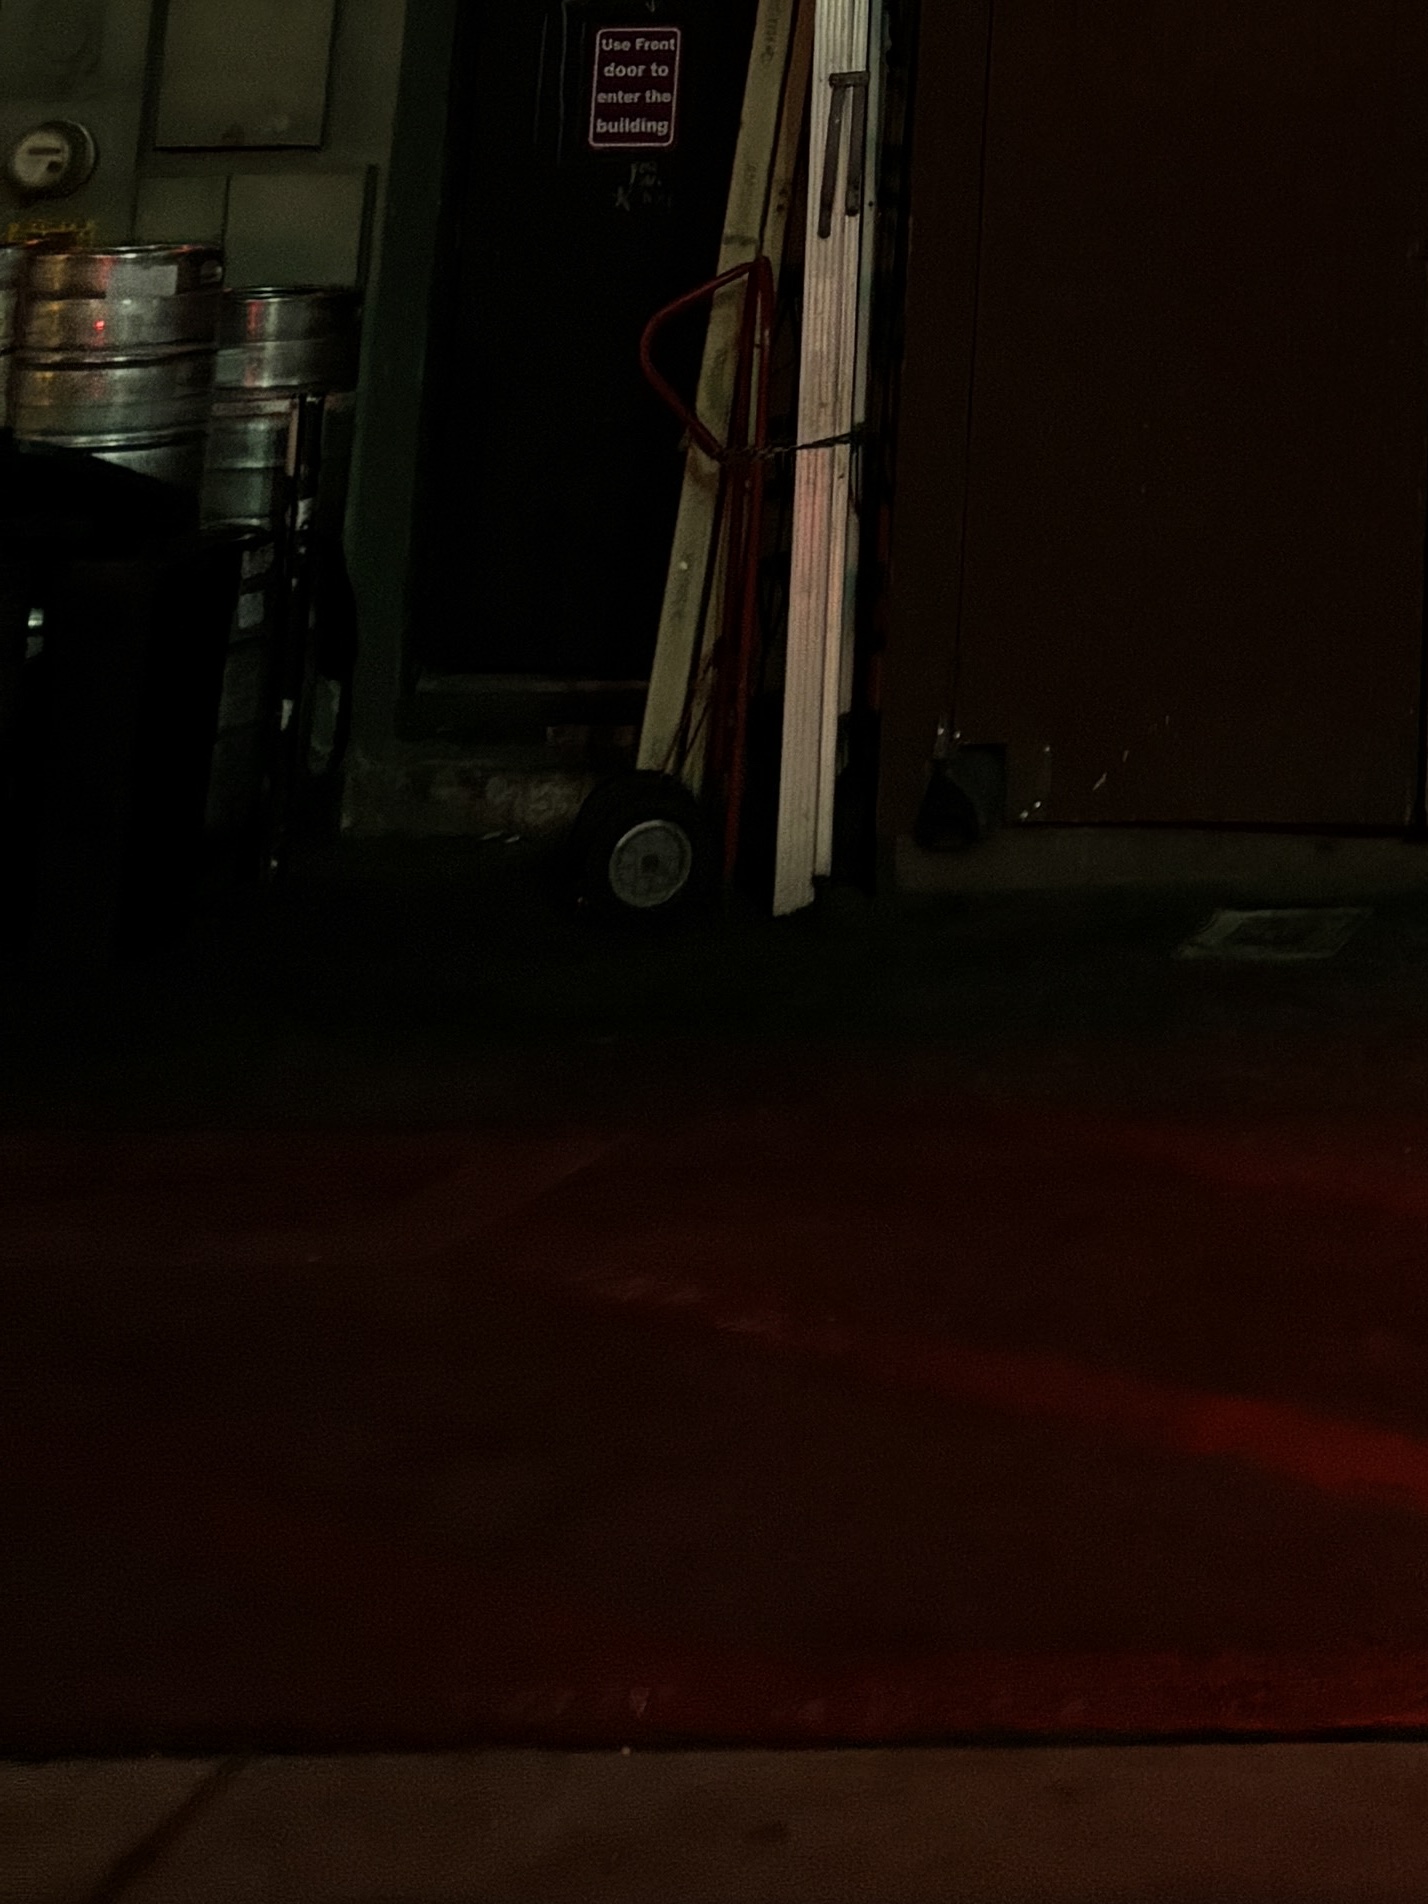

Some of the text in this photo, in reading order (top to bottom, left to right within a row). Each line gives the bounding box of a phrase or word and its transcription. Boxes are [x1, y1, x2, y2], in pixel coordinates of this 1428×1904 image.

[601, 37, 675, 52] Use Front
[603, 62, 669, 77] door to
[596, 89, 672, 104] enter the
[595, 117, 669, 136] building
